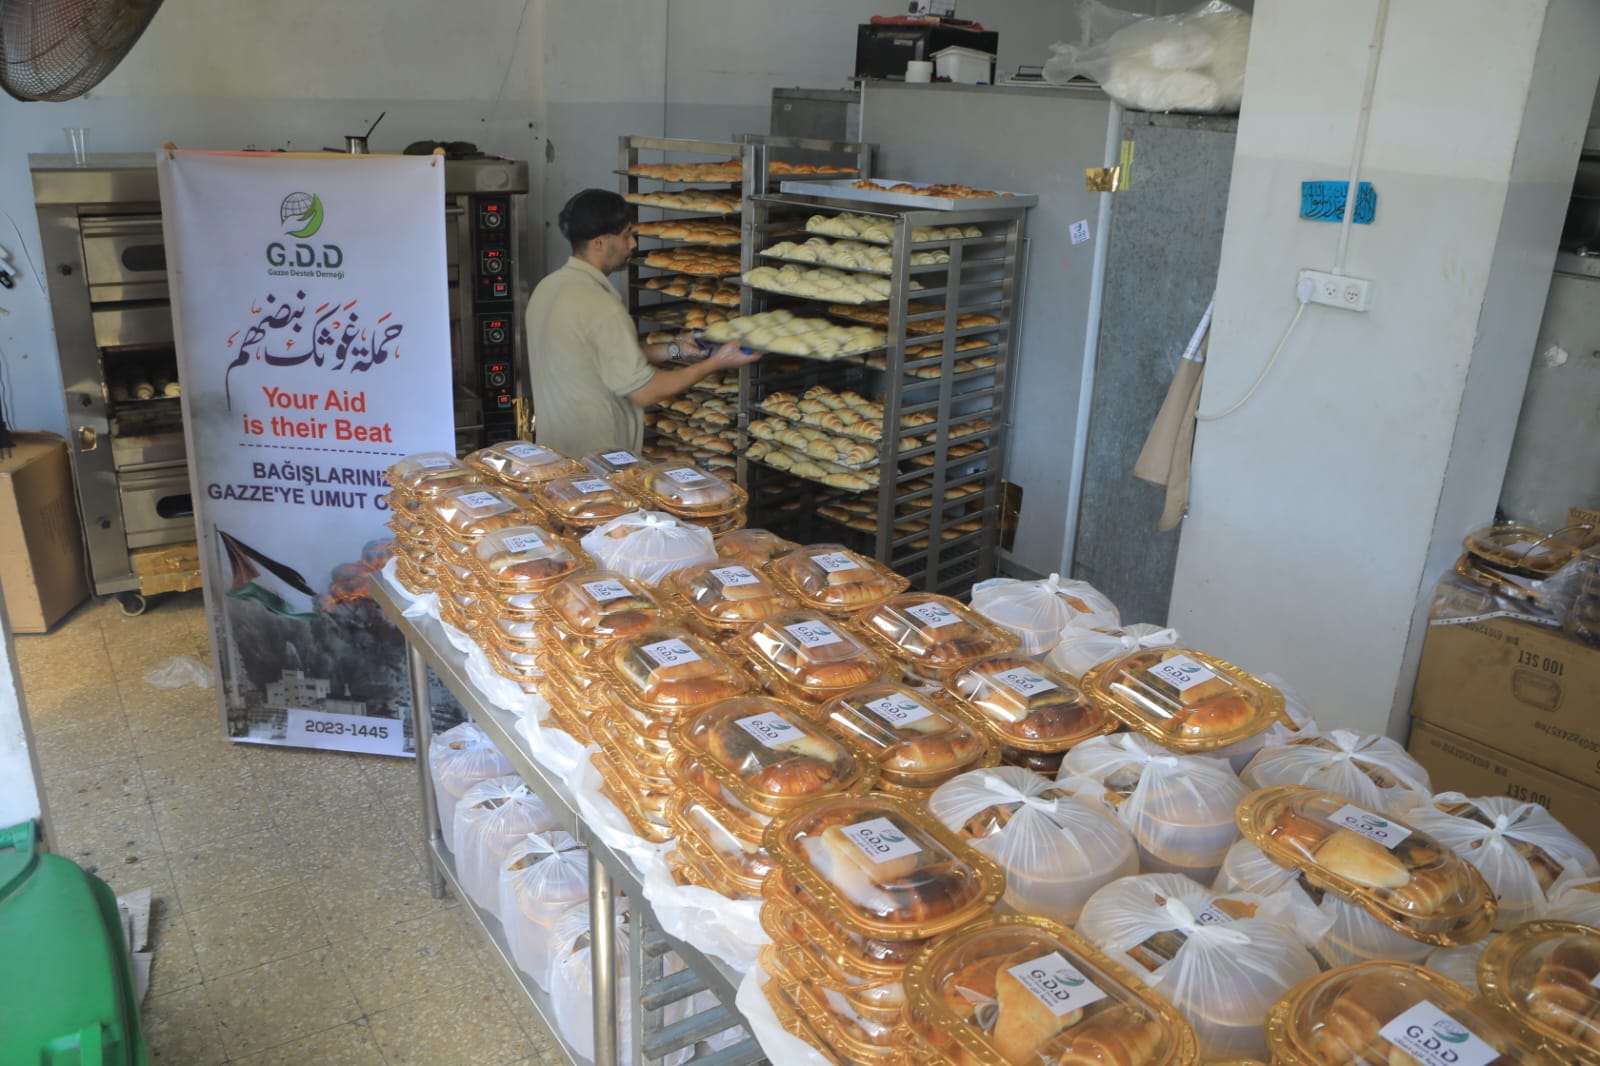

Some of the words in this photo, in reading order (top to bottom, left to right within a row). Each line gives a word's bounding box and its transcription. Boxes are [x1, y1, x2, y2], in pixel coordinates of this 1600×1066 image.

[266, 242, 344, 269] G.D.D
[267, 268, 289, 277] Gazze
[290, 269, 314, 278] Destek
[262, 385, 319, 410] Your
[324, 389, 366, 413] Aid
[242, 413, 264, 436] is
[271, 415, 328, 439] their
[335, 418, 393, 443] Beat
[207, 483, 305, 504] GAZZE'YE
[311, 489, 368, 509] UMUT
[919, 608, 942, 623] G.D.D
[798, 626, 820, 643] G.D.D
[1518, 650, 1540, 668] SET
[1543, 658, 1564, 677] 100
[1007, 674, 1035, 690] G.D.D
[1163, 665, 1191, 683] G.D.D
[881, 702, 908, 720] G.D.D
[752, 719, 780, 739] G.D.D
[1506, 783, 1529, 802] SET
[860, 828, 891, 853] G.D.D
[1031, 969, 1070, 1000] G.D.D
[1406, 1025, 1459, 1063] G.D.D
